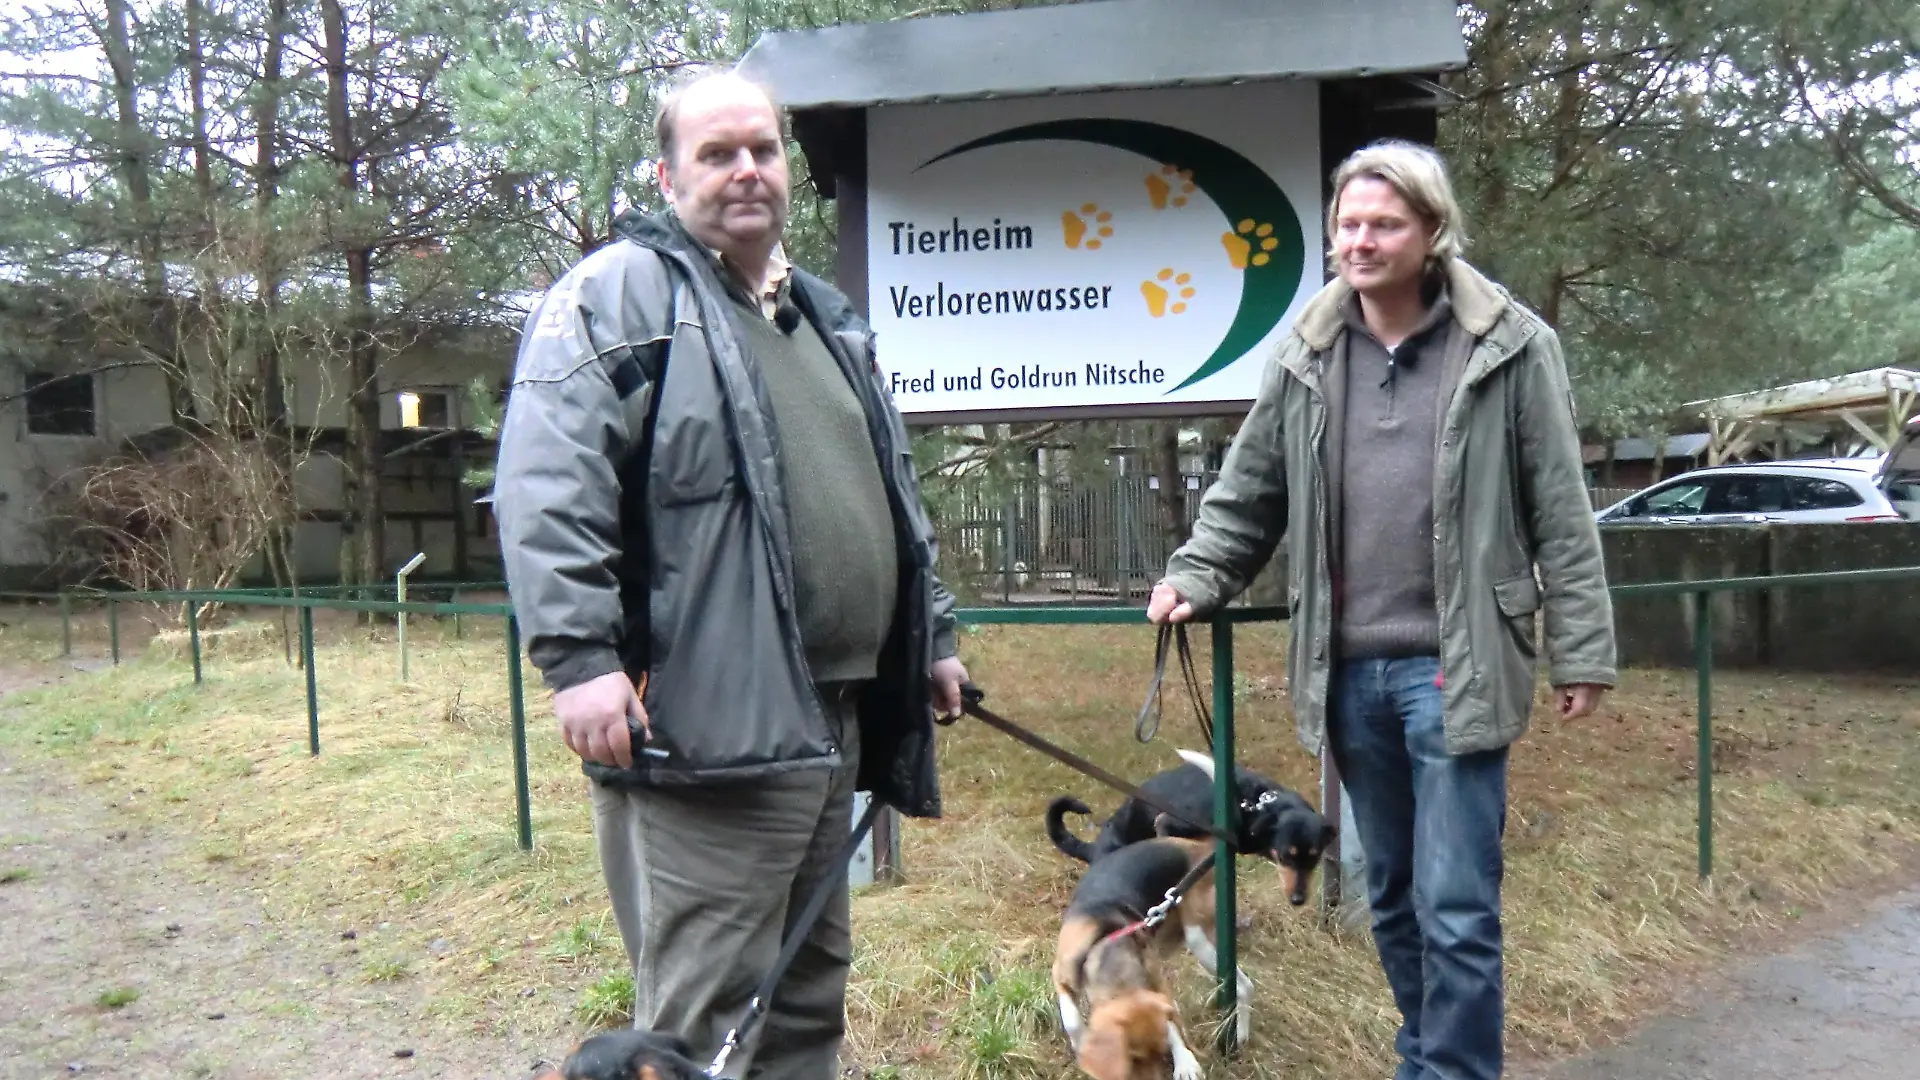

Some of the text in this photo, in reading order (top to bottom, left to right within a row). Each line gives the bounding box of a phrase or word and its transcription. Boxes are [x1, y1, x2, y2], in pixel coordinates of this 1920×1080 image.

[888, 217, 1033, 255] Tierheim
[889, 282, 1112, 318] Verlorenwasser
[891, 360, 1165, 394] Fred und Goldrun Nitsche
